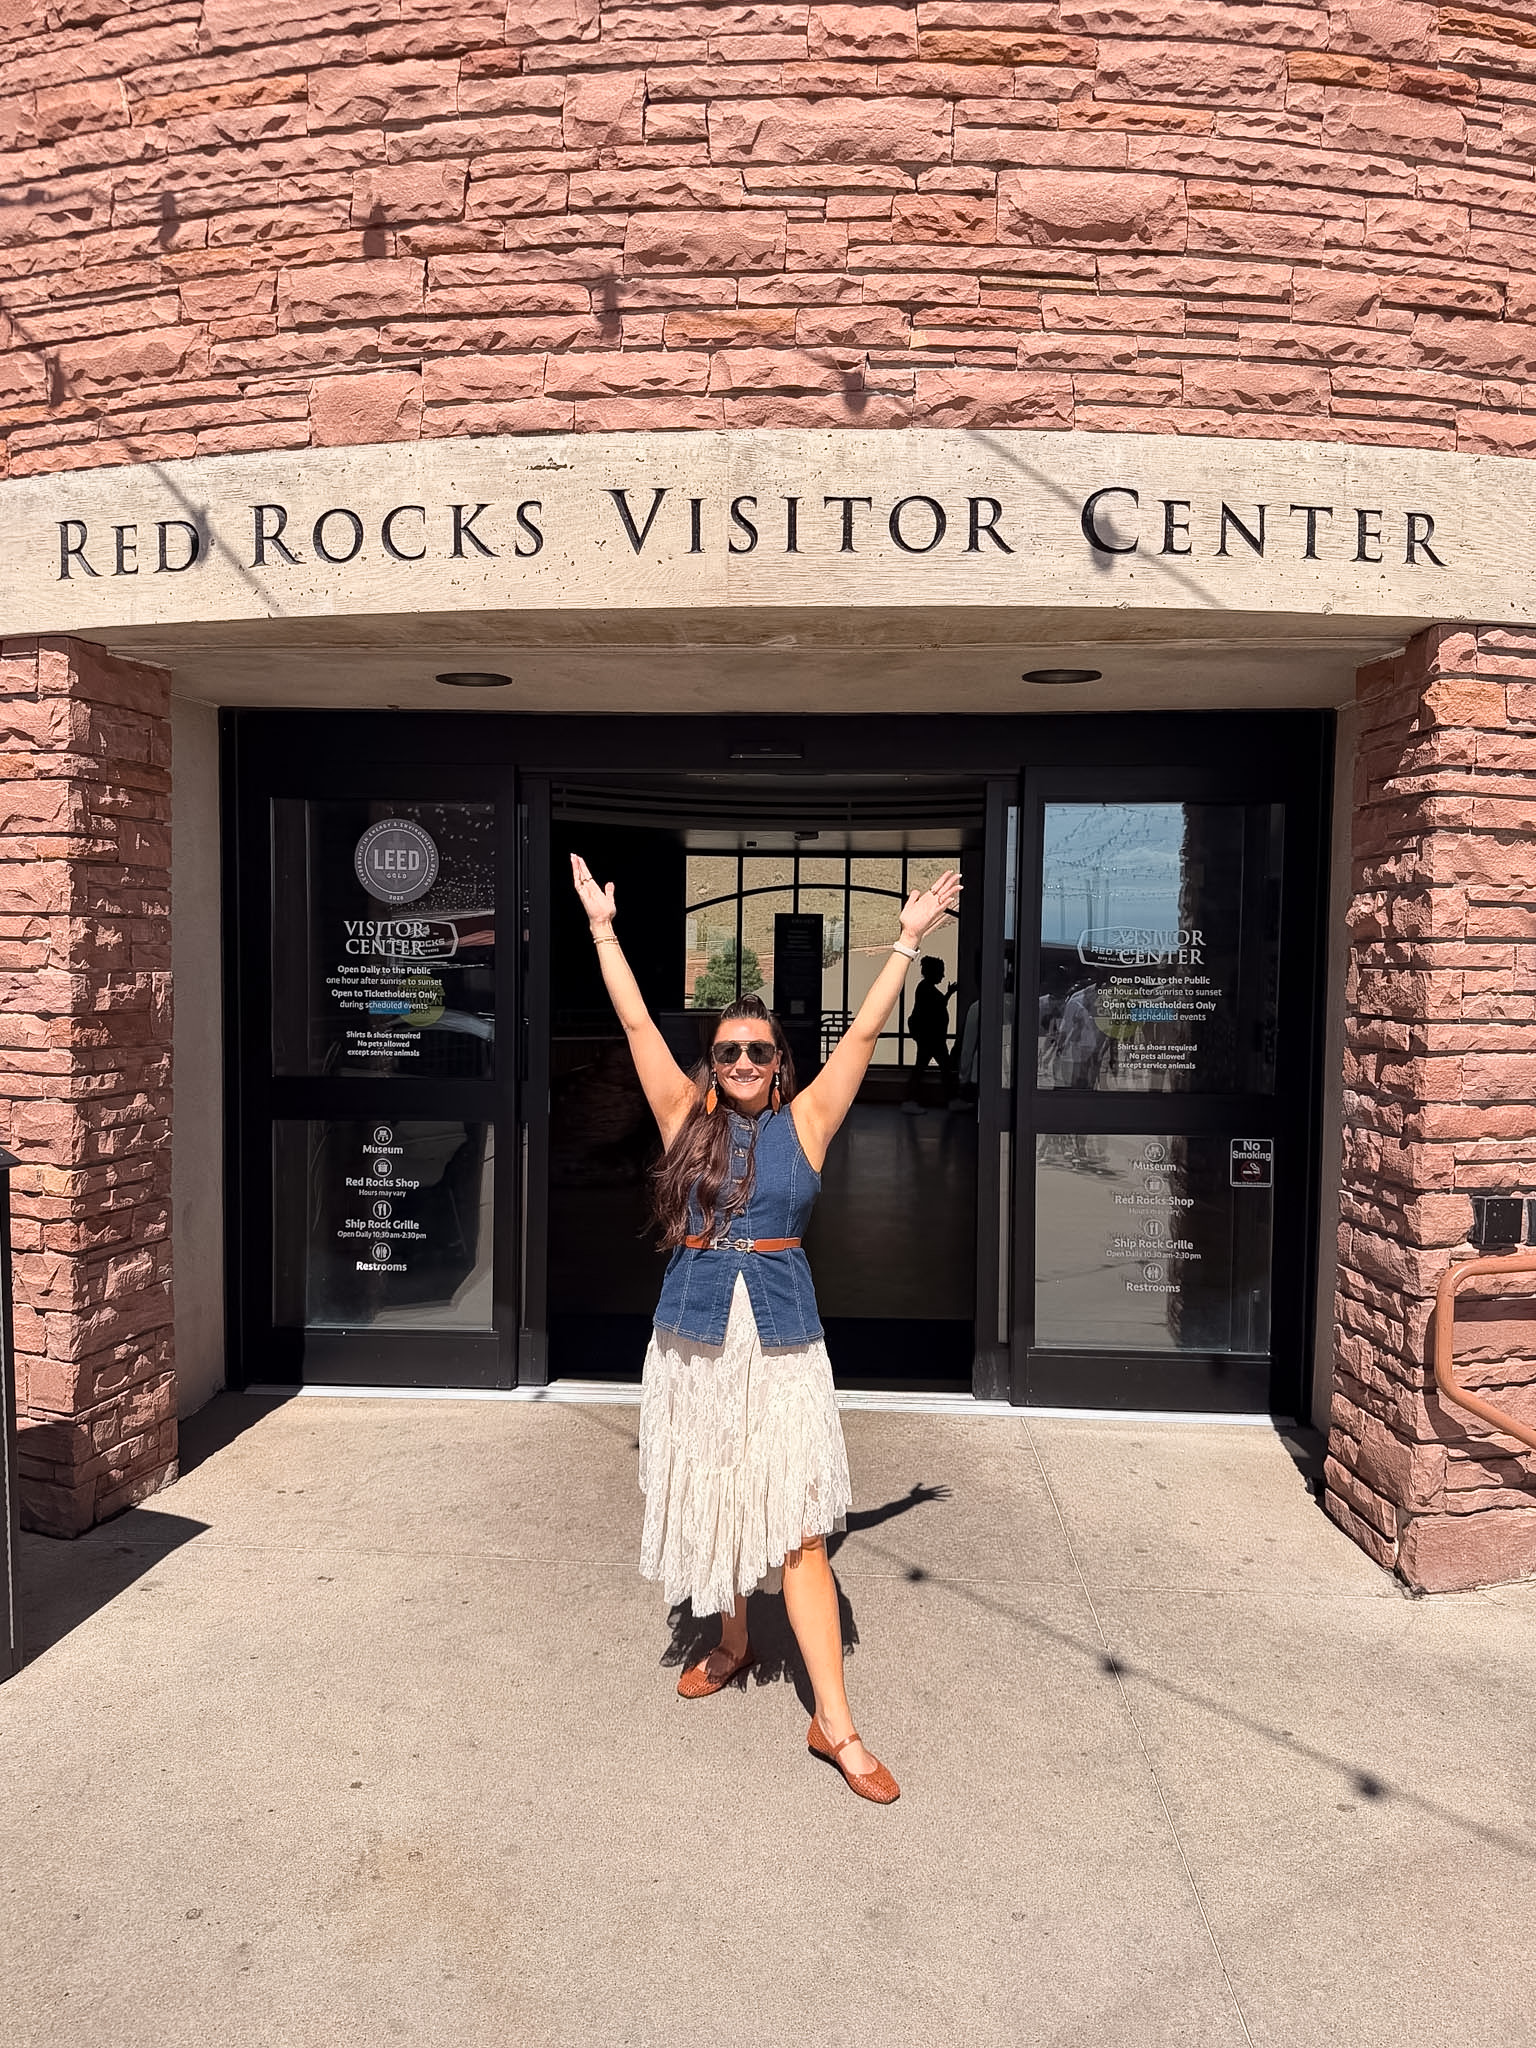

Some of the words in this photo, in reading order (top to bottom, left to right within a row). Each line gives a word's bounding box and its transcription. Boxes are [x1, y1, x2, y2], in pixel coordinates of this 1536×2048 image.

[55, 519, 200, 581] RED
[248, 501, 545, 568] ROCKS
[601, 487, 1016, 555] VISITOR
[1081, 486, 1447, 568] CENTER
[374, 849, 420, 871] LEED
[344, 921, 426, 938] VISITOR
[346, 939, 425, 955] CENTER
[1119, 950, 1204, 965] CENTER
[338, 965, 359, 974] Open
[361, 966, 381, 974] Daily
[392, 966, 405, 974] the
[407, 967, 431, 975] Public
[342, 976, 359, 984] hour
[360, 976, 378, 984] after
[1110, 976, 1132, 985] Open
[1134, 976, 1156, 985] Daily
[1184, 976, 1210, 984] Public
[332, 989, 353, 998] Open
[364, 990, 416, 998] Ticketholders
[418, 991, 437, 1000] Only
[1134, 987, 1153, 995] after
[1154, 988, 1183, 996] sunrise
[340, 1001, 364, 1010] during
[365, 1001, 402, 1009] scheduled
[1103, 1001, 1125, 1010] Open
[1137, 1001, 1194, 1010] Ticketholders
[1196, 1002, 1216, 1011] Only
[393, 1032, 420, 1040] required
[1168, 1044, 1197, 1052] required
[1119, 1062, 1141, 1070] except
[362, 1145, 403, 1154] Museum
[1243, 1141, 1260, 1151] No
[1232, 1151, 1271, 1161] Smoking
[1133, 1162, 1176, 1172] Museum
[346, 1178, 363, 1187] Red
[366, 1178, 393, 1187] Rocks
[395, 1178, 420, 1189] Shop
[1115, 1195, 1134, 1204] Red
[1137, 1196, 1167, 1205] Rocks
[1168, 1196, 1194, 1208] Shop
[345, 1219, 366, 1230] Ship
[368, 1220, 391, 1229] Rock
[393, 1221, 419, 1229] Grille
[337, 1231, 354, 1239] Open
[1114, 1239, 1136, 1250] Ship
[1139, 1240, 1163, 1248] Rock
[1166, 1240, 1193, 1249] Grille
[356, 1262, 407, 1271] Restrooms
[1126, 1283, 1180, 1292] Restrooms
